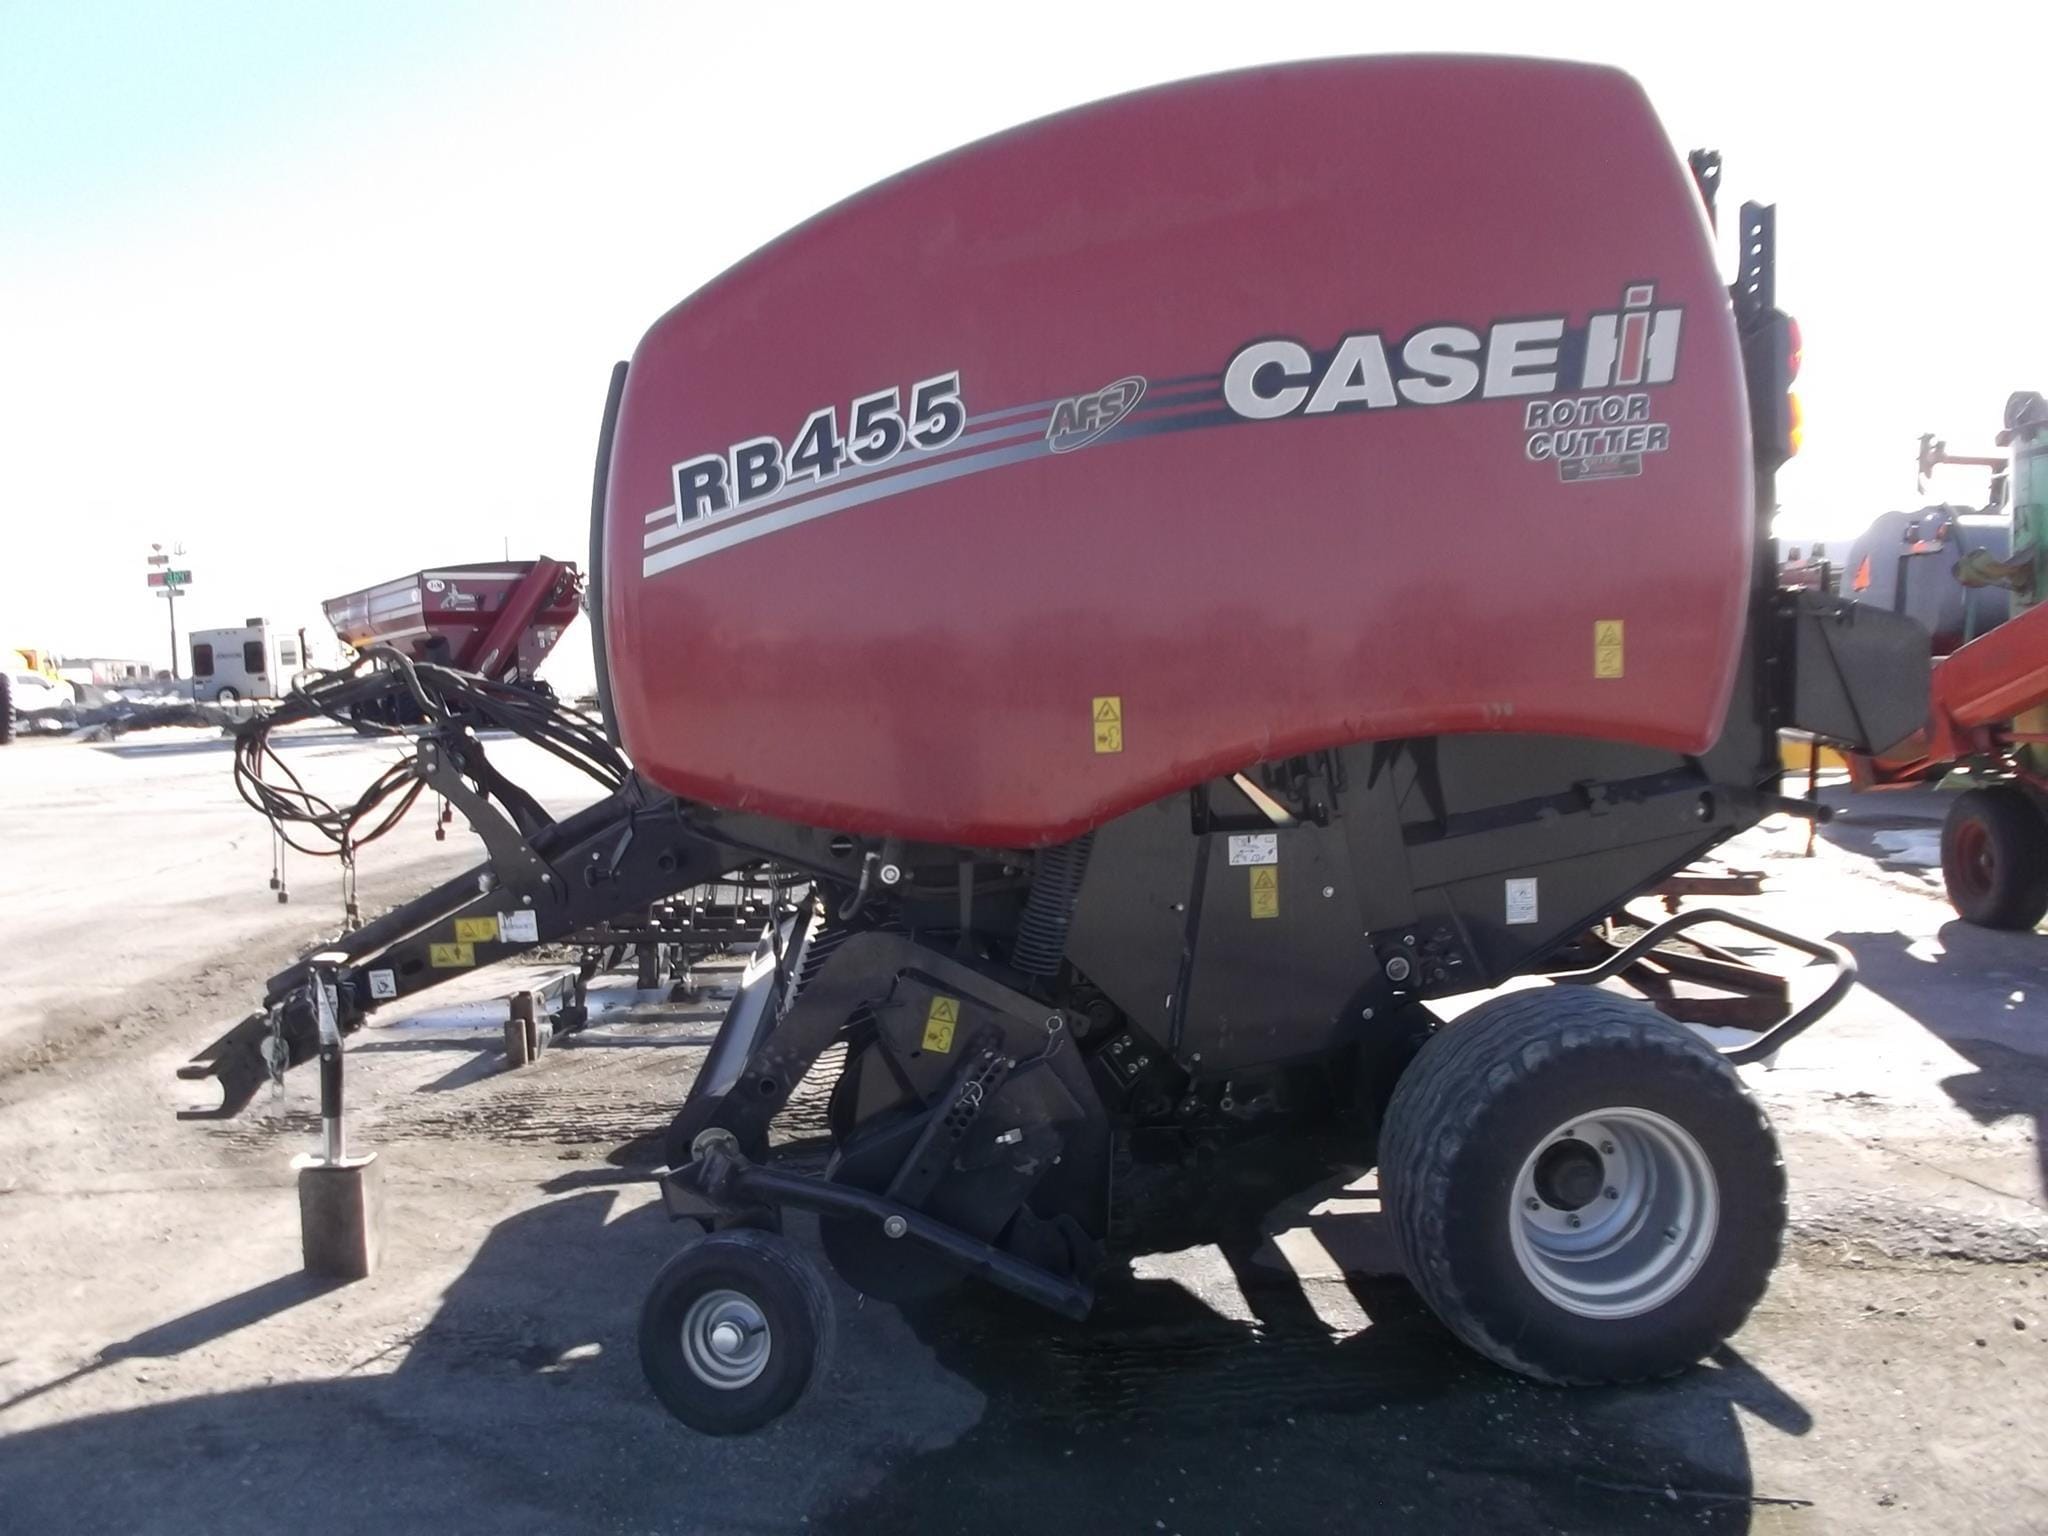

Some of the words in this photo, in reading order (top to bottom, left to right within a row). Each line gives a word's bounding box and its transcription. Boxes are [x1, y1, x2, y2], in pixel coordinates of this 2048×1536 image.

[1224, 318, 1565, 420] CASE
[1045, 386, 1127, 440] AFS
[1524, 393, 1650, 431] ROTOR
[671, 369, 967, 529] RB455
[1526, 423, 1670, 461] CUTTER
